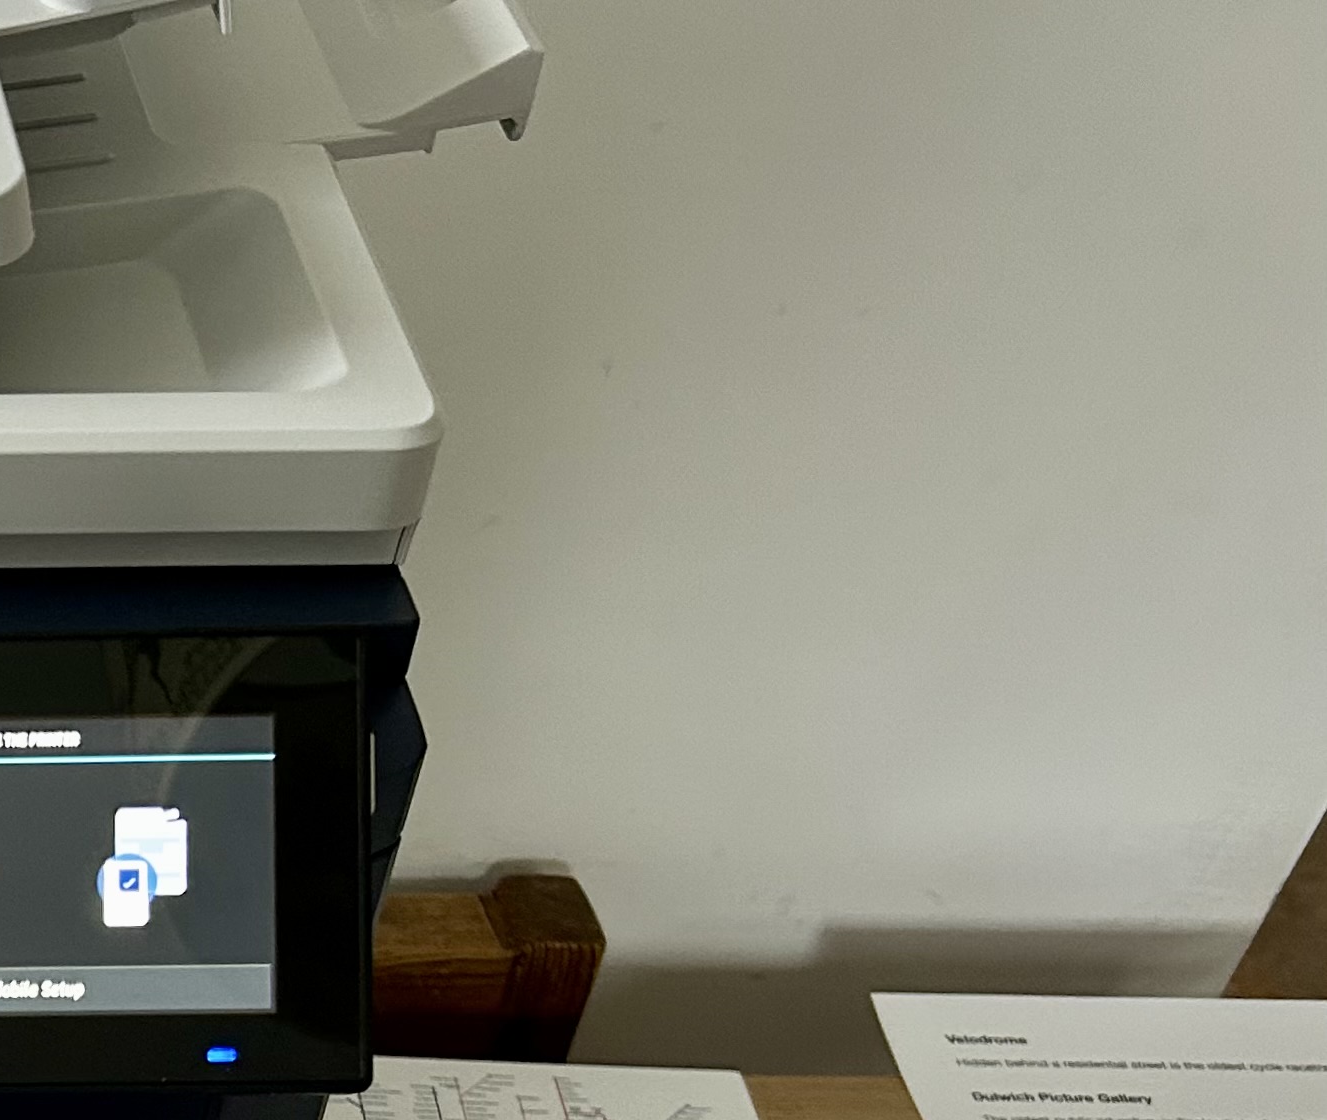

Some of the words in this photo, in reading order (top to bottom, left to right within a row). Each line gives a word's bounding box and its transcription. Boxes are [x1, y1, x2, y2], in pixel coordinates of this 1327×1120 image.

[41, 980, 85, 1001] Setup
[972, 1091, 1035, 1102] Dulwich
[1097, 1093, 1151, 1105] Gallery
